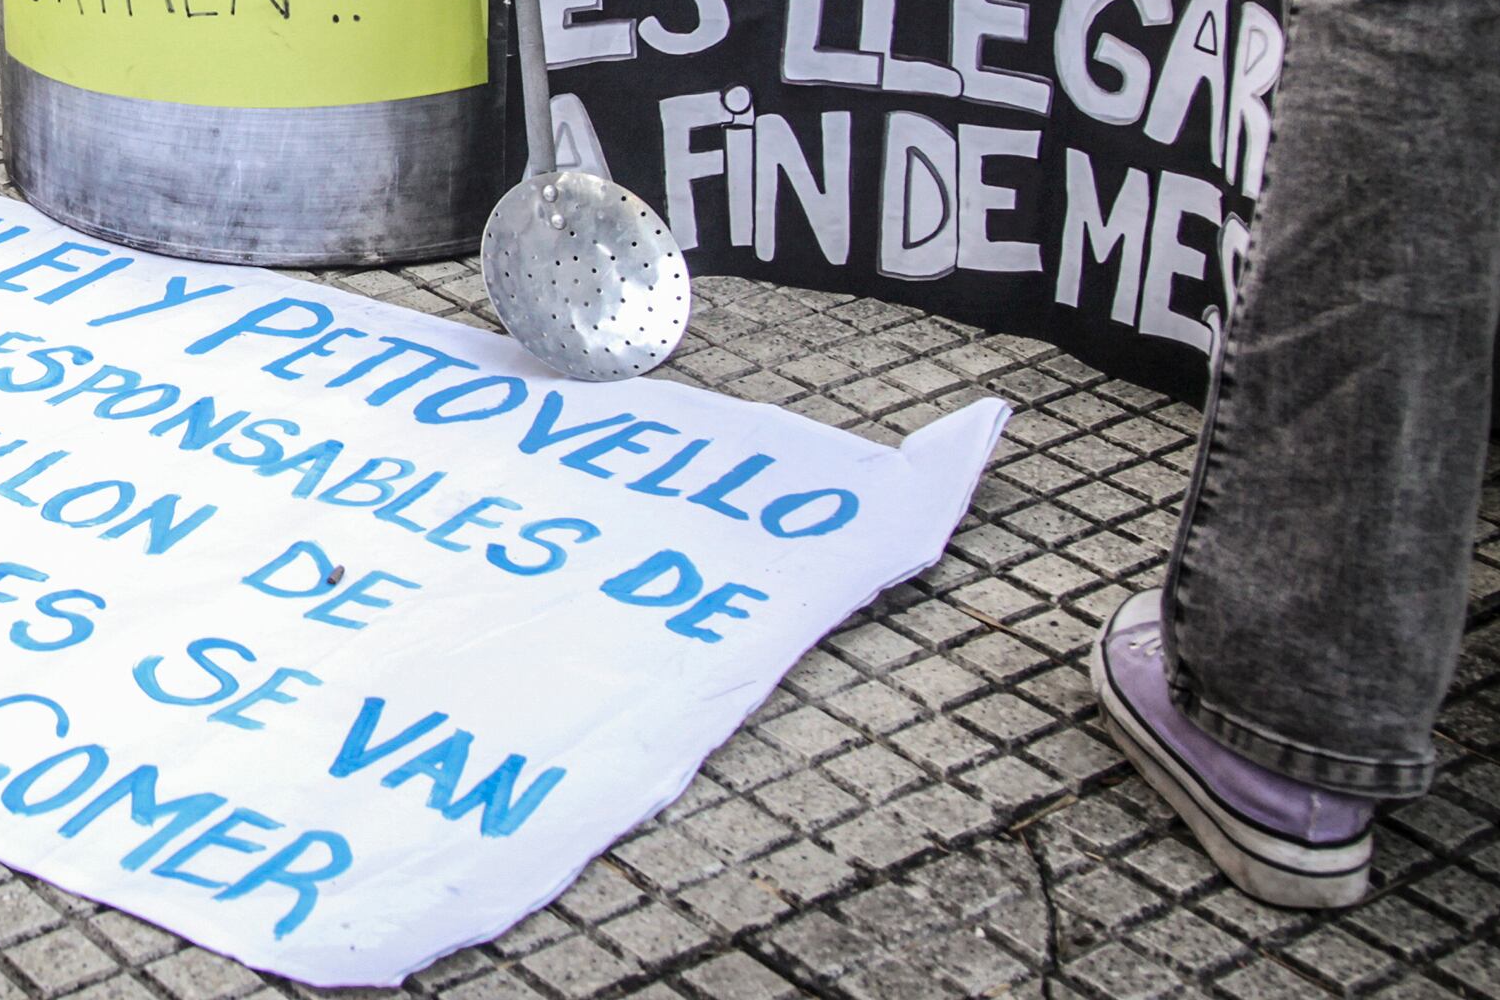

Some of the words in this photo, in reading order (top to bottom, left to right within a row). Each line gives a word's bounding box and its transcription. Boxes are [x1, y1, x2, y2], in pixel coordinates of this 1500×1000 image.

[877, 109, 1043, 280] DE
[87, 276, 234, 327] Y
[184, 297, 860, 538] PETTOVELLO
[241, 540, 421, 629] DE
[600, 549, 769, 643] DE
[132, 637, 324, 730] SE
[328, 697, 567, 838] VAN
